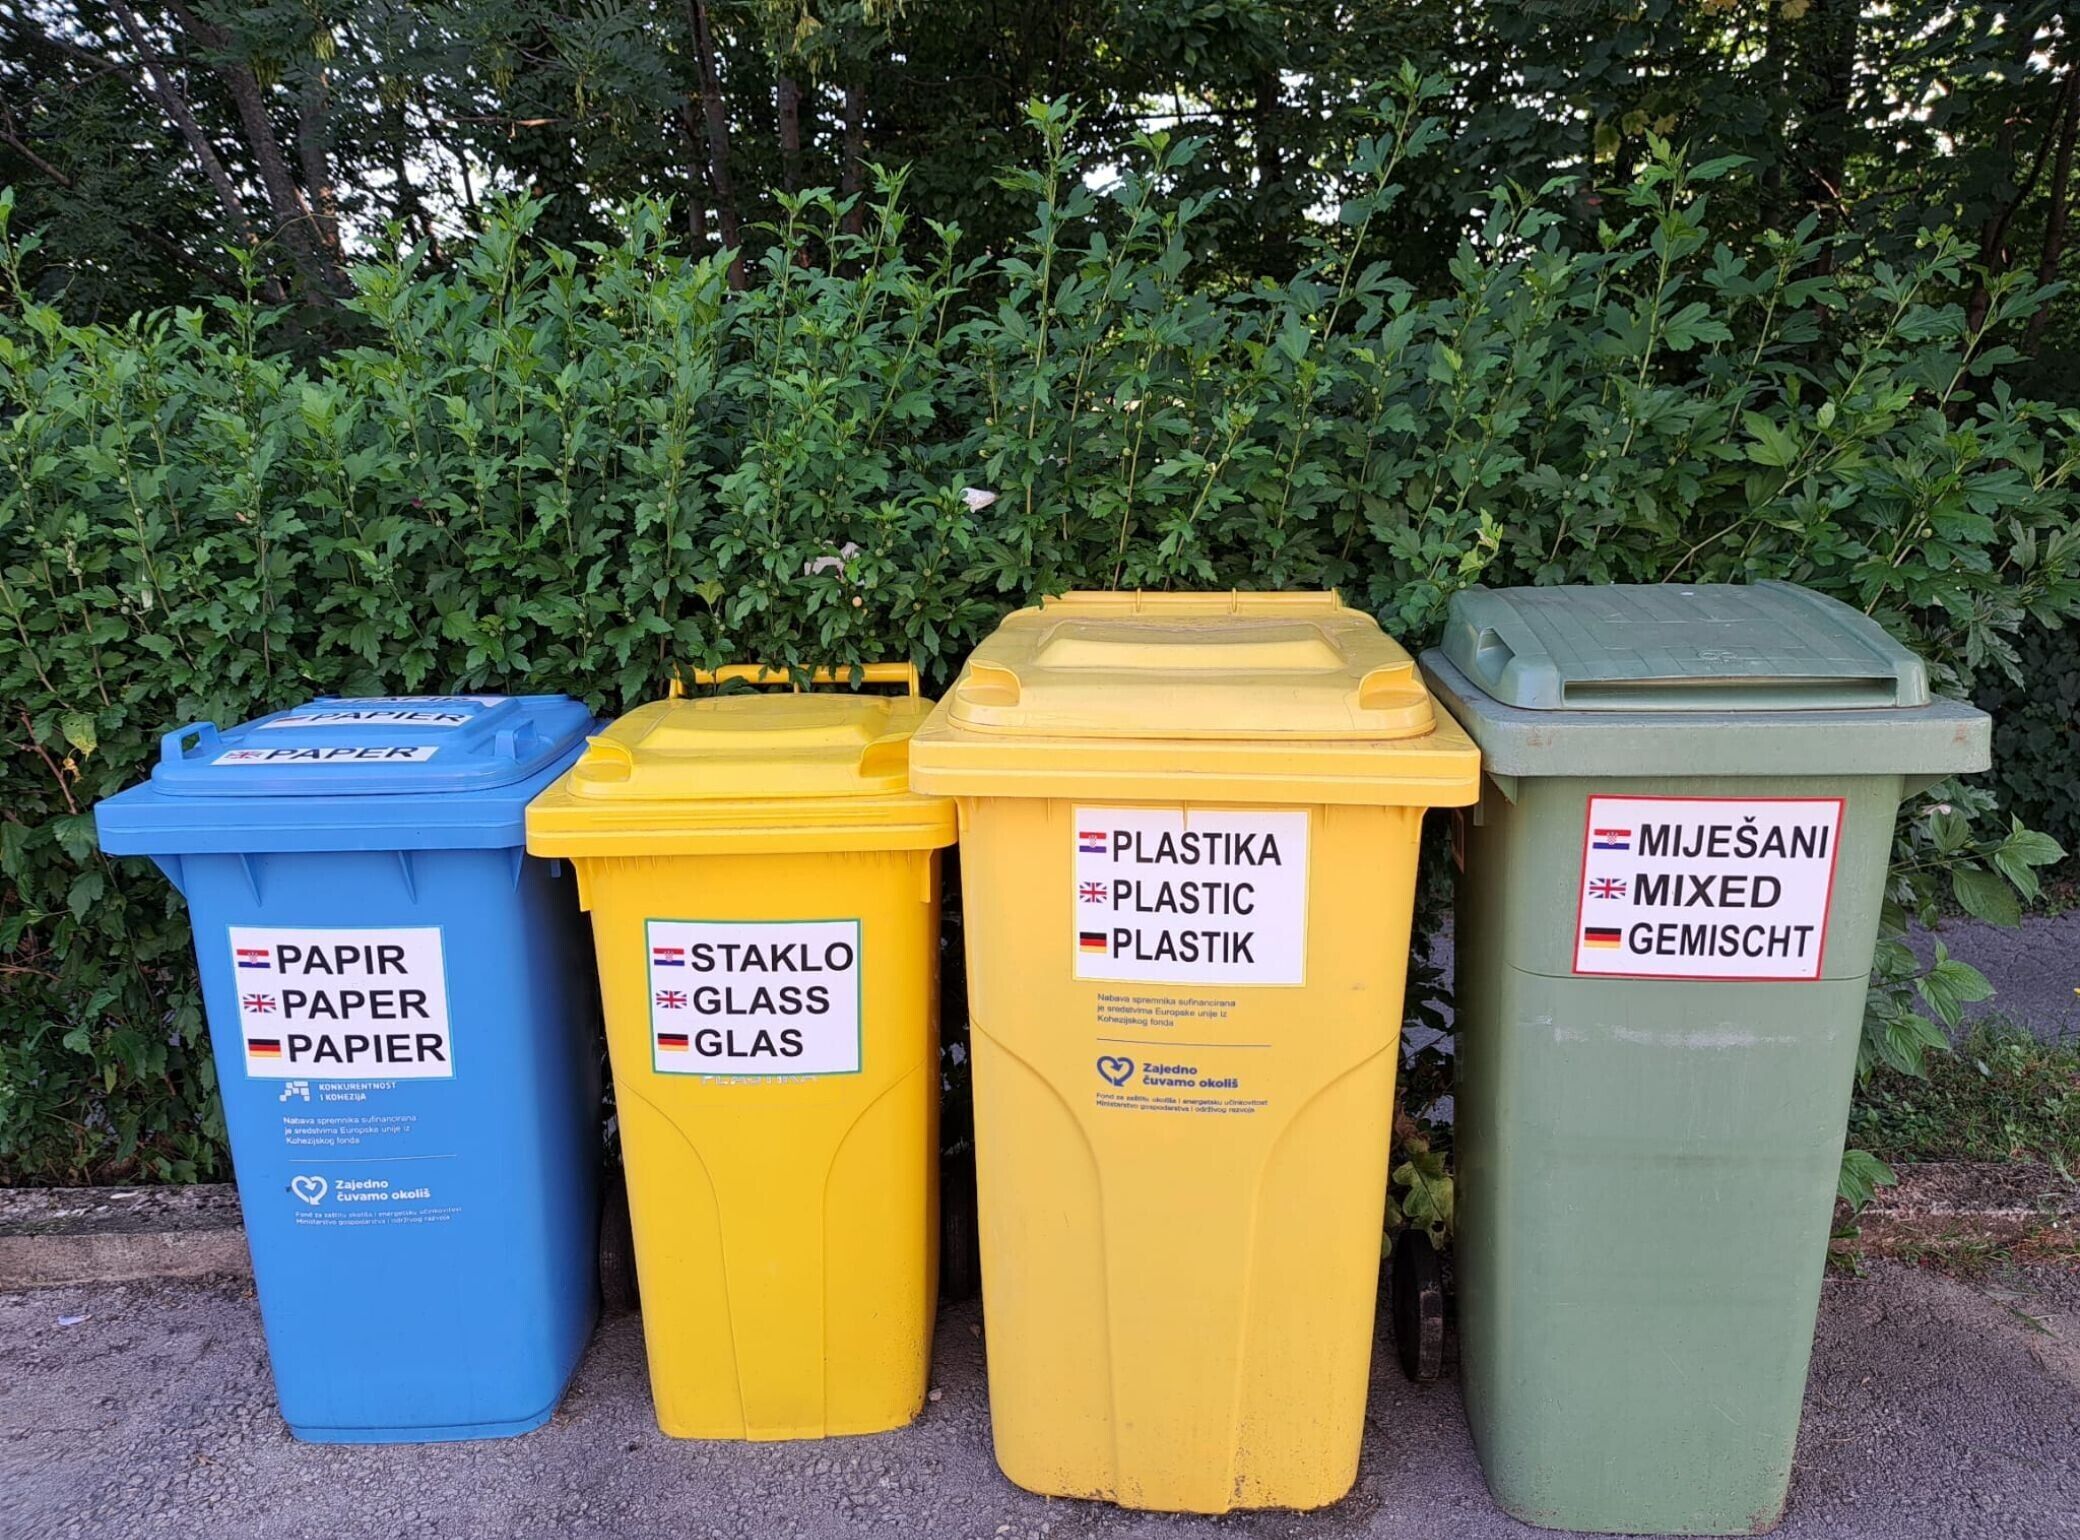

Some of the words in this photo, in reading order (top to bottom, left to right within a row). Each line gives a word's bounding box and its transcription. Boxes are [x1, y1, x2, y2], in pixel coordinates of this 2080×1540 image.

[309, 711, 466, 722] PAPIER
[264, 747, 420, 760] PAPER
[1638, 816, 1829, 858] MIJEŠANI
[1113, 830, 1282, 866] PLASTIKA
[1113, 879, 1255, 915] PLASTIC
[1633, 873, 1782, 908] MIXED
[1113, 927, 1255, 963] PLASTIK
[1628, 922, 1814, 957] GEMISCHT
[276, 944, 408, 975] PAPIR
[691, 942, 854, 973] STAKLO
[282, 989, 430, 1019] PAPER
[693, 985, 830, 1015] GLASS
[1097, 993, 1130, 1003] Nabava
[1132, 996, 1176, 1006] spremnika
[1178, 998, 1236, 1007] sufinancirana
[1097, 1005, 1105, 1013] je
[1155, 1007, 1195, 1017] Europske
[1197, 1010, 1218, 1019] unije
[1097, 1015, 1148, 1026] Kohezijskog
[1150, 1018, 1174, 1027] fonda
[287, 1033, 446, 1063] PAPIER
[694, 1028, 803, 1057] GLAS
[1143, 1063, 1198, 1075] Zajedno
[319, 1082, 396, 1091] KONKURENTNOST
[1142, 1075, 1195, 1088] čuvamo
[1198, 1078, 1239, 1089] okoliš
[326, 1093, 367, 1101] KOHEZIJA
[283, 1116, 315, 1125] Nabava
[335, 1179, 389, 1191] Zajedno
[337, 1191, 389, 1202] čuvamo
[391, 1188, 431, 1200] okoliš
